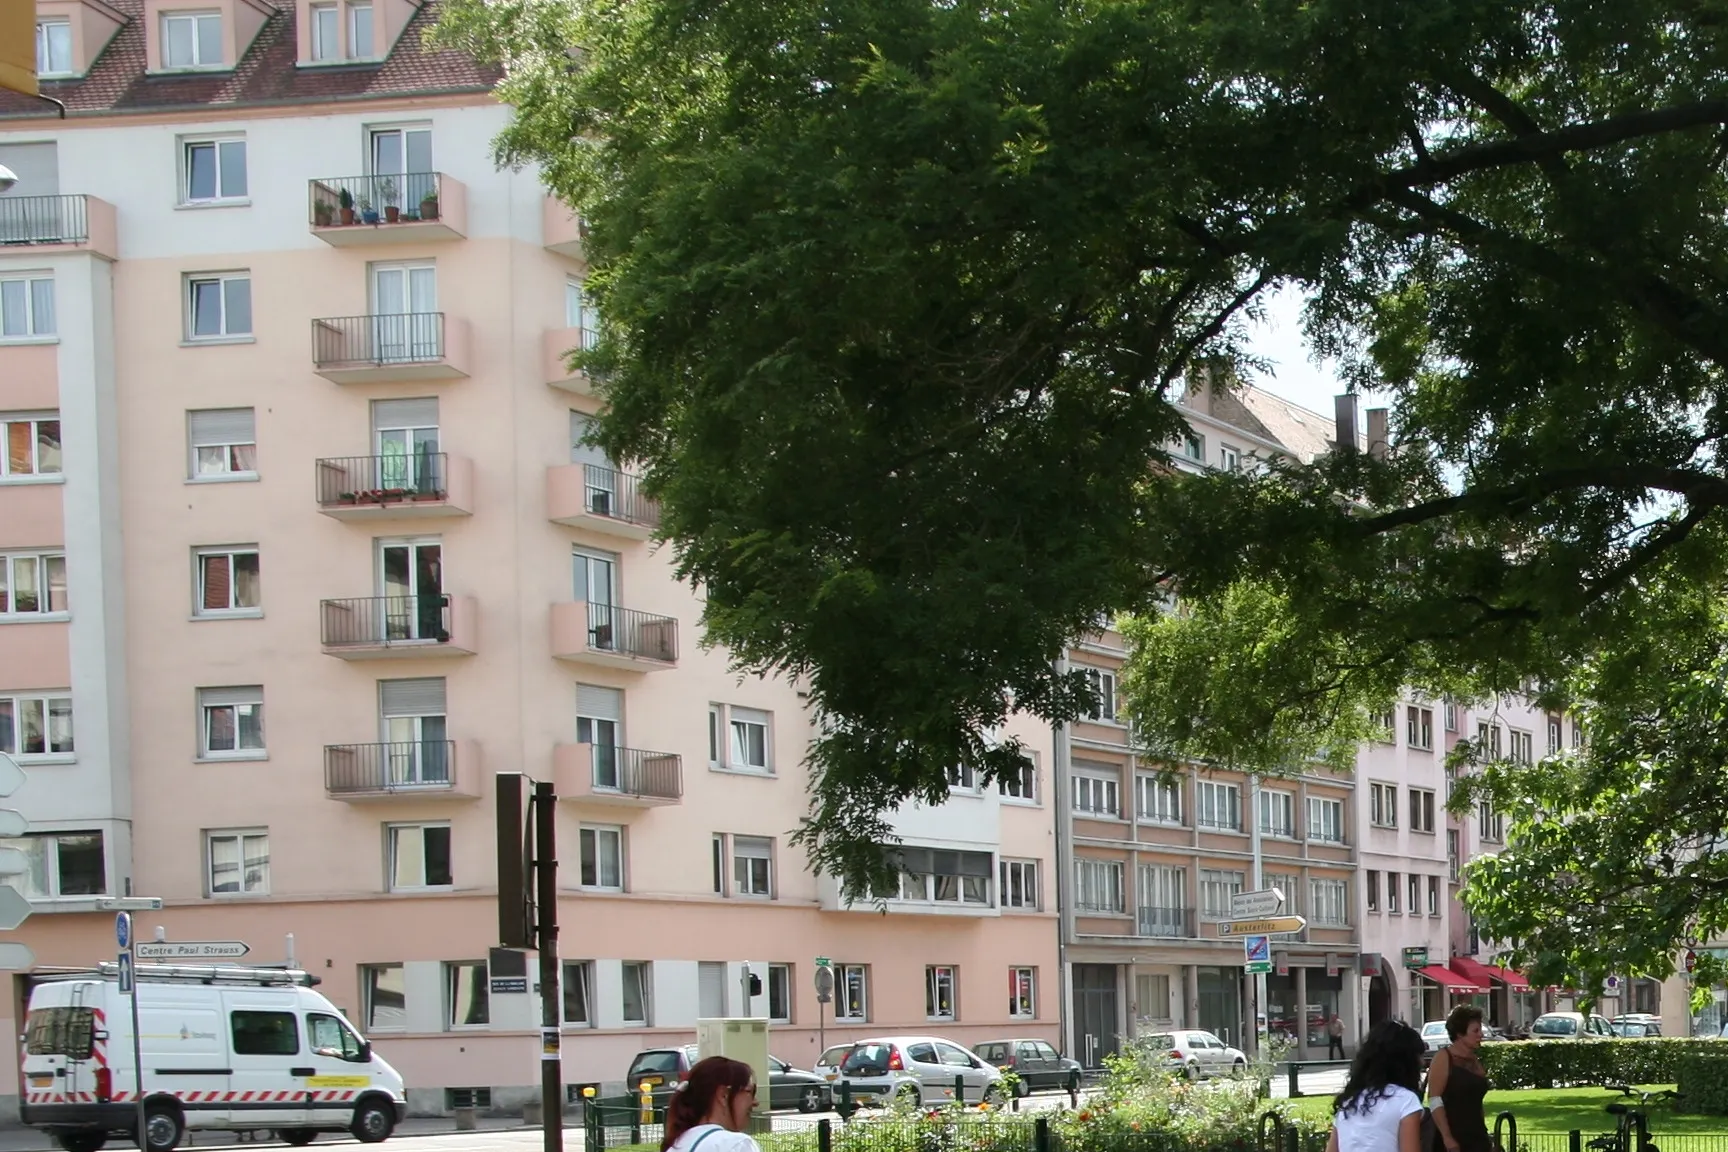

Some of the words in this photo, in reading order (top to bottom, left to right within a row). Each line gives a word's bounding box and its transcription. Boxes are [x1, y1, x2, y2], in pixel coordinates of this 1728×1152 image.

[1233, 923, 1276, 933] Austerlitz
[140, 946, 173, 955] Centre
[178, 945, 199, 955] Paul
[204, 945, 240, 955] Strauss
